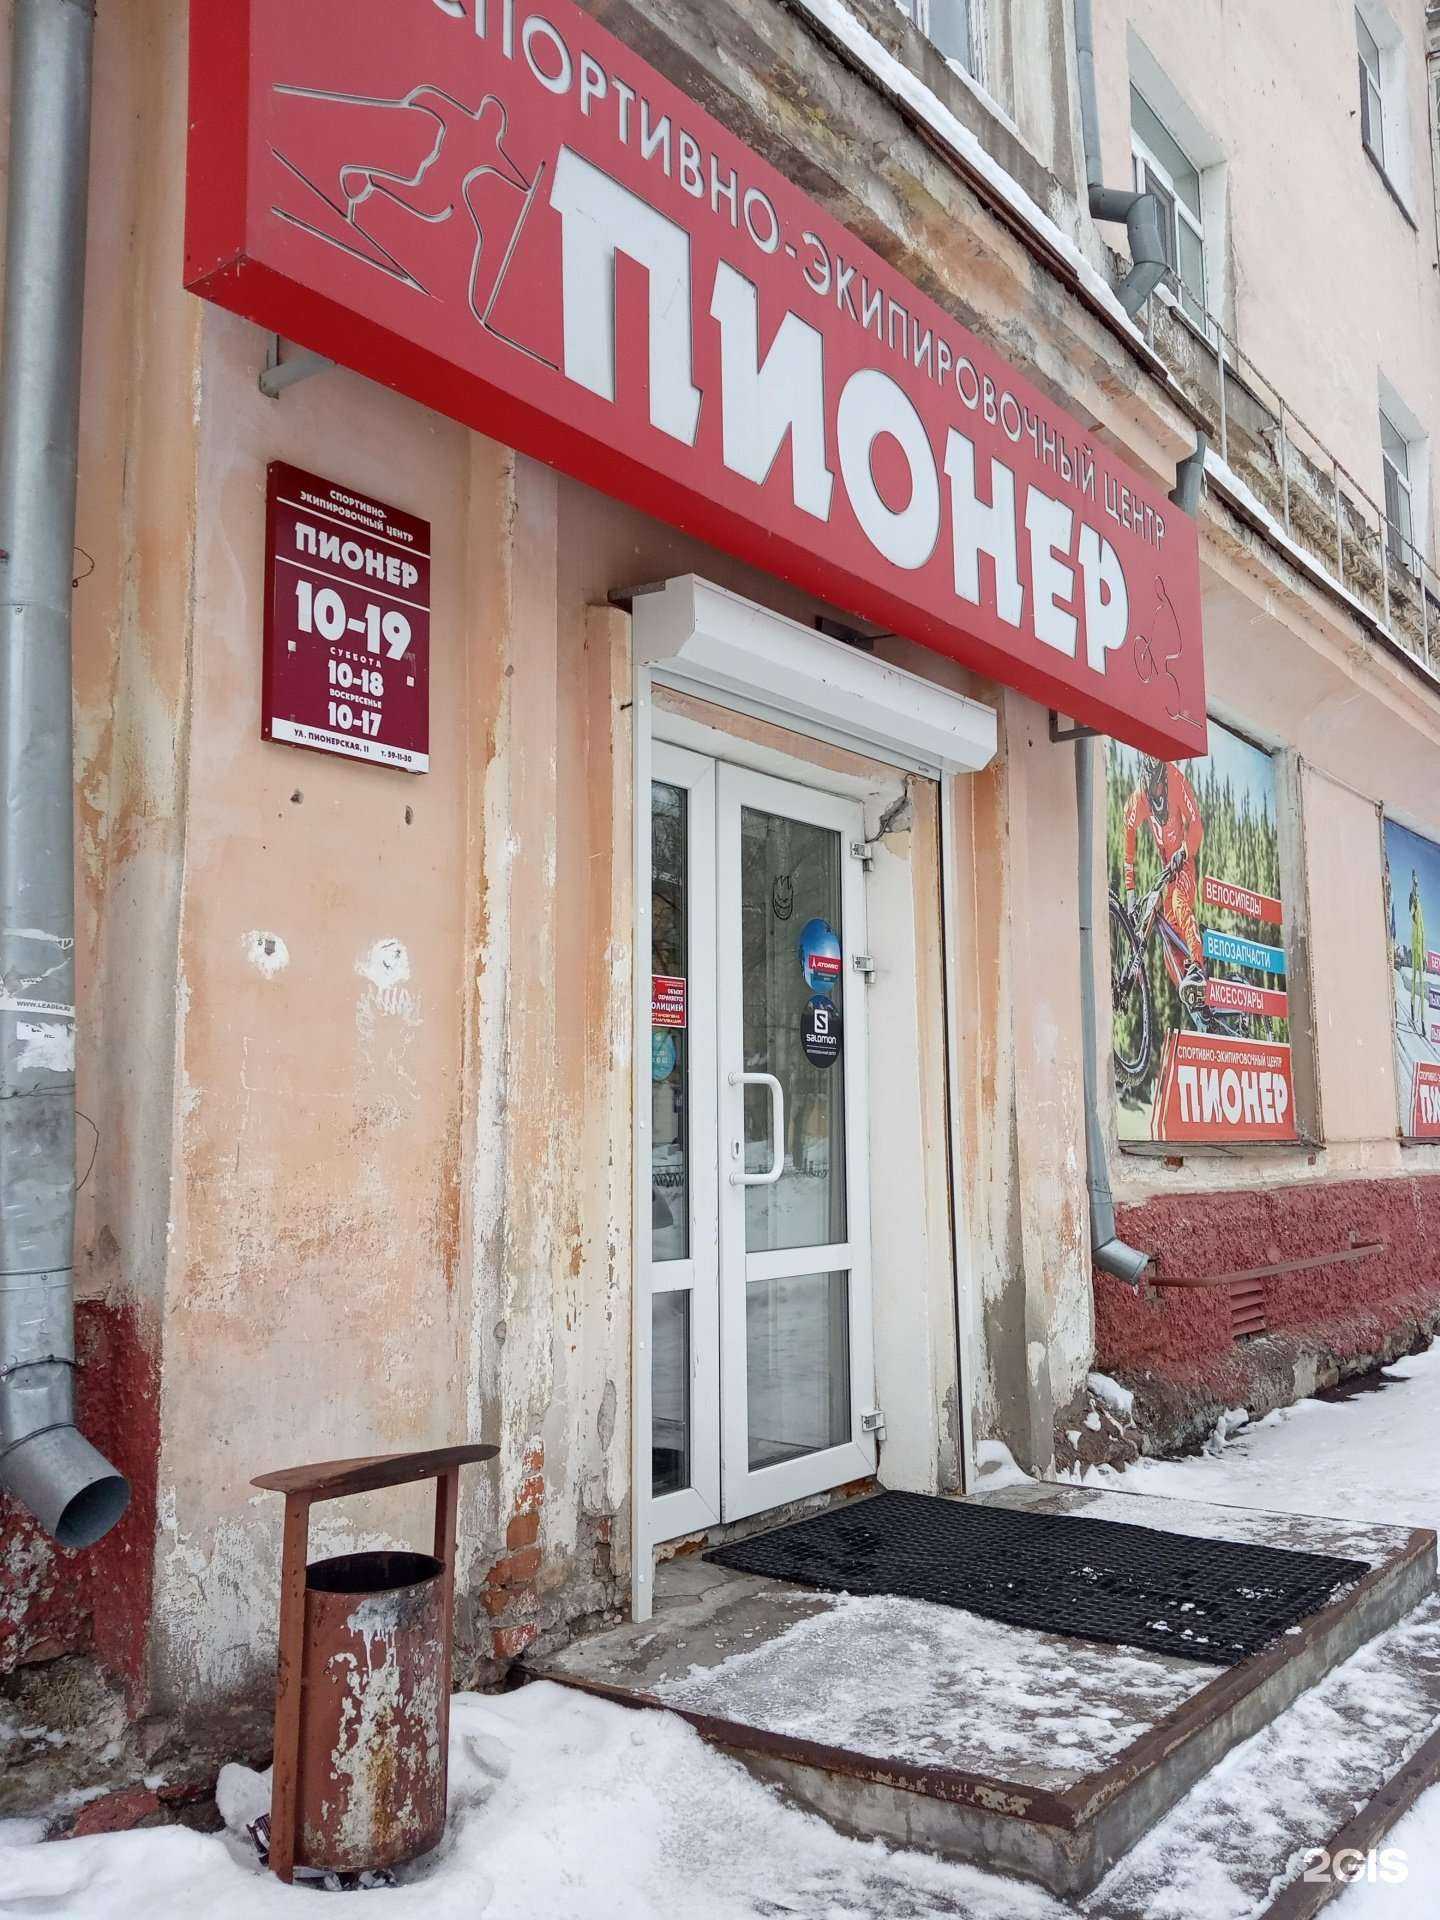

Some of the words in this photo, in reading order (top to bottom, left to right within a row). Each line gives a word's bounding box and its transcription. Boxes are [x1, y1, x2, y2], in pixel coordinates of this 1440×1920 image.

[432, 0, 1096, 502] ПОРТИВНО-ЭКИПИРОВОЧНЫЙ
[1104, 471, 1166, 551] ЦЕНТР
[548, 143, 1130, 676] ПИОНЕР
[300, 490, 384, 532] ЭКИПИРОВОЧНЫЙ
[386, 525, 414, 542] ЦЕНТР
[329, 490, 387, 519] СПОРТИВНО-
[295, 522, 418, 589] ПИОНЕР
[295, 579, 412, 661] 10-19
[329, 646, 382, 668] СУББОТА
[328, 659, 384, 697] 10-18
[329, 688, 382, 709] ВОСКРЕСЕНЬЕ
[328, 701, 382, 737] 10-17
[1206, 883, 1262, 917] ВЕЛОСИПЕДЫ
[816, 961, 839, 970] ATOMIC
[1207, 935, 1272, 969] ВЕЛОЗАПЧАСТИ
[651, 1001, 684, 1013] ОЛИЦИЕЙ
[1209, 983, 1264, 1010] АКСЕССУАРЫ
[1177, 1065, 1289, 1125] ПИОНЕР
